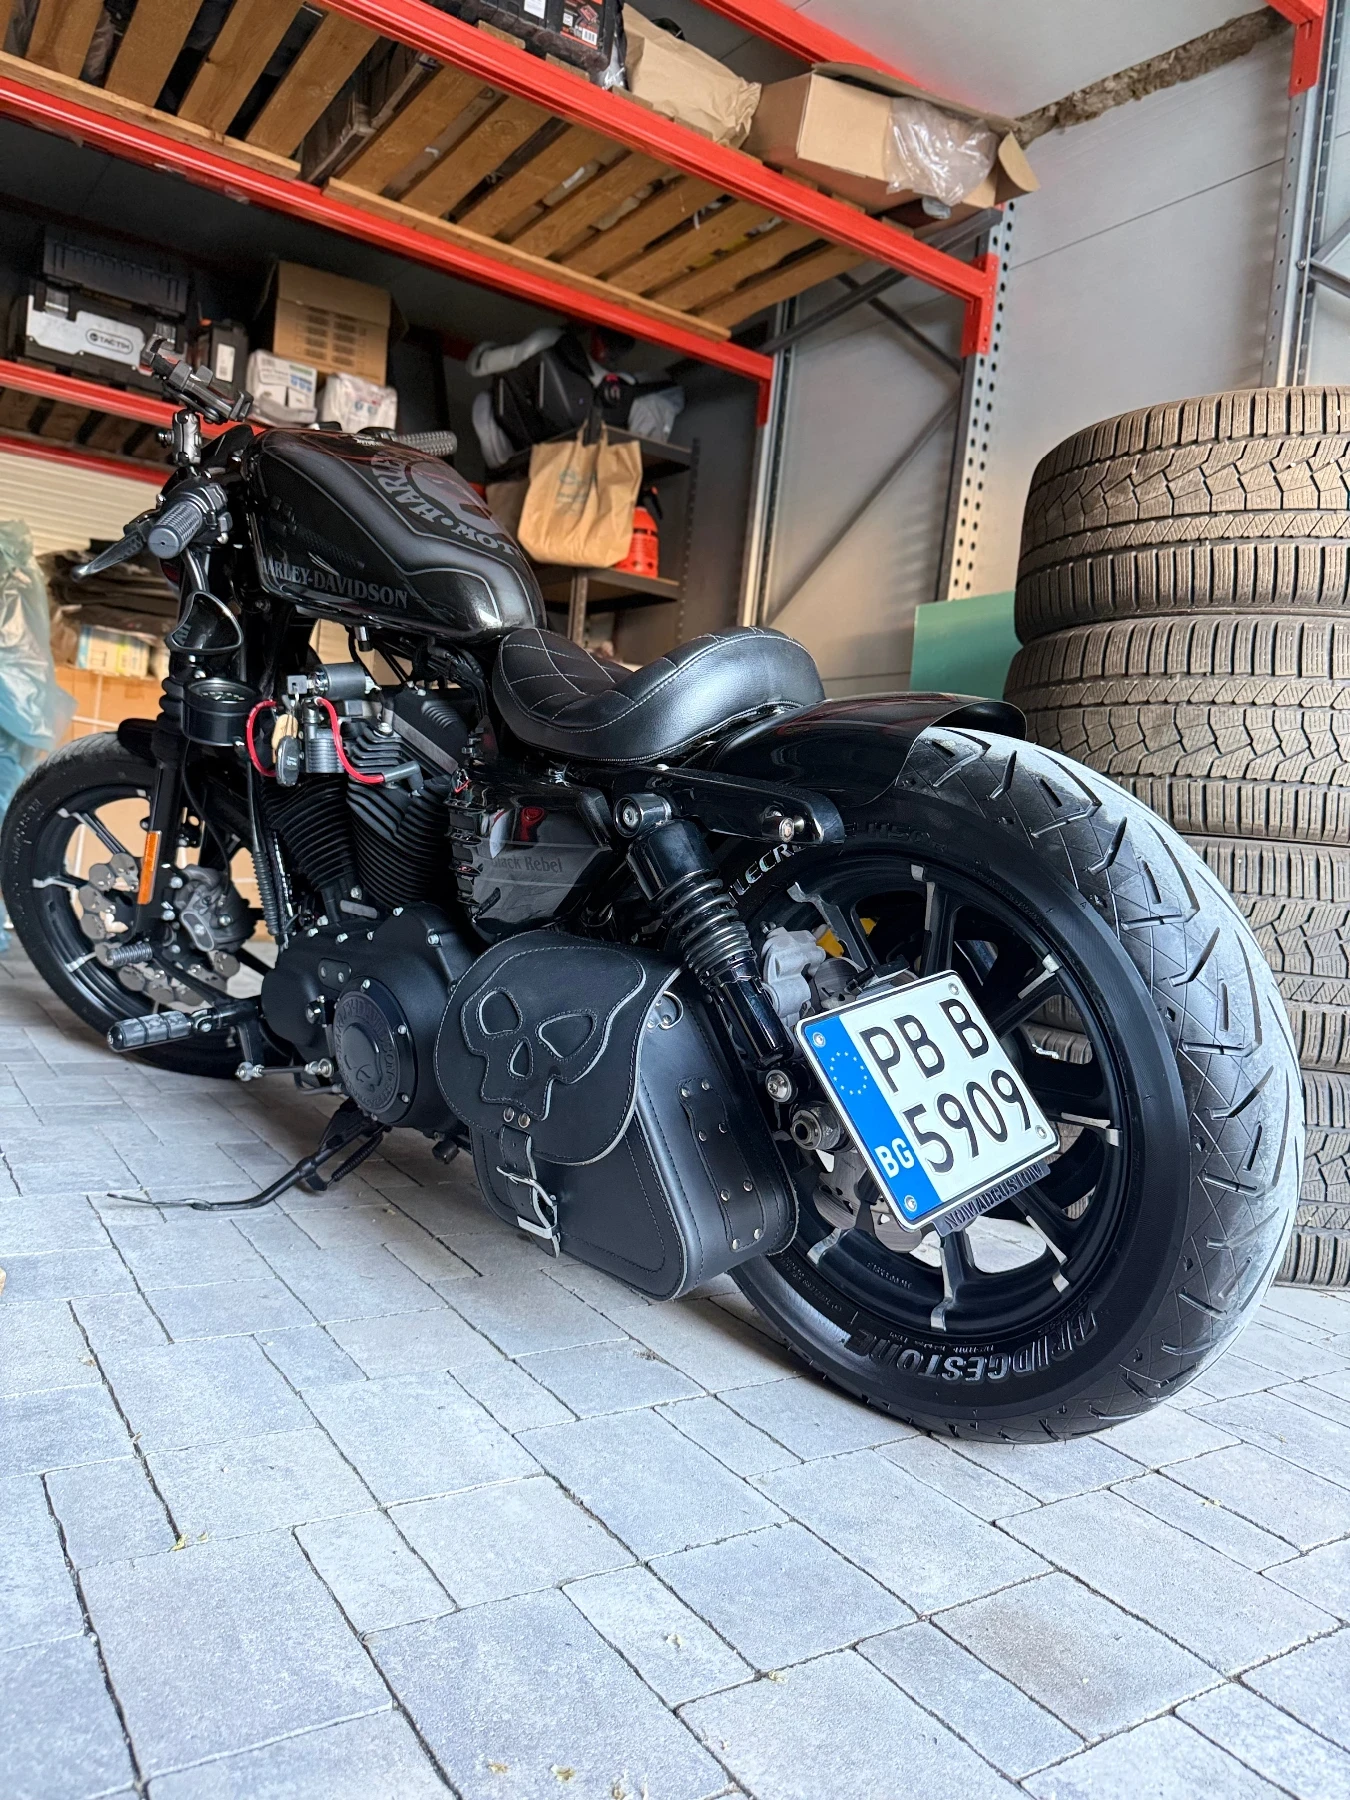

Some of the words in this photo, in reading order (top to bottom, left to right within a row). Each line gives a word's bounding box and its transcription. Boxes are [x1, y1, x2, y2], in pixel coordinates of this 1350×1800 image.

[525, 856, 563, 873] Rebel
[858, 1014, 946, 1095] PB
[938, 998, 990, 1060] B
[873, 1136, 915, 1179] BG
[902, 1069, 1032, 1174] 5909
[844, 1310, 1099, 1384] BRIDGESTONE
